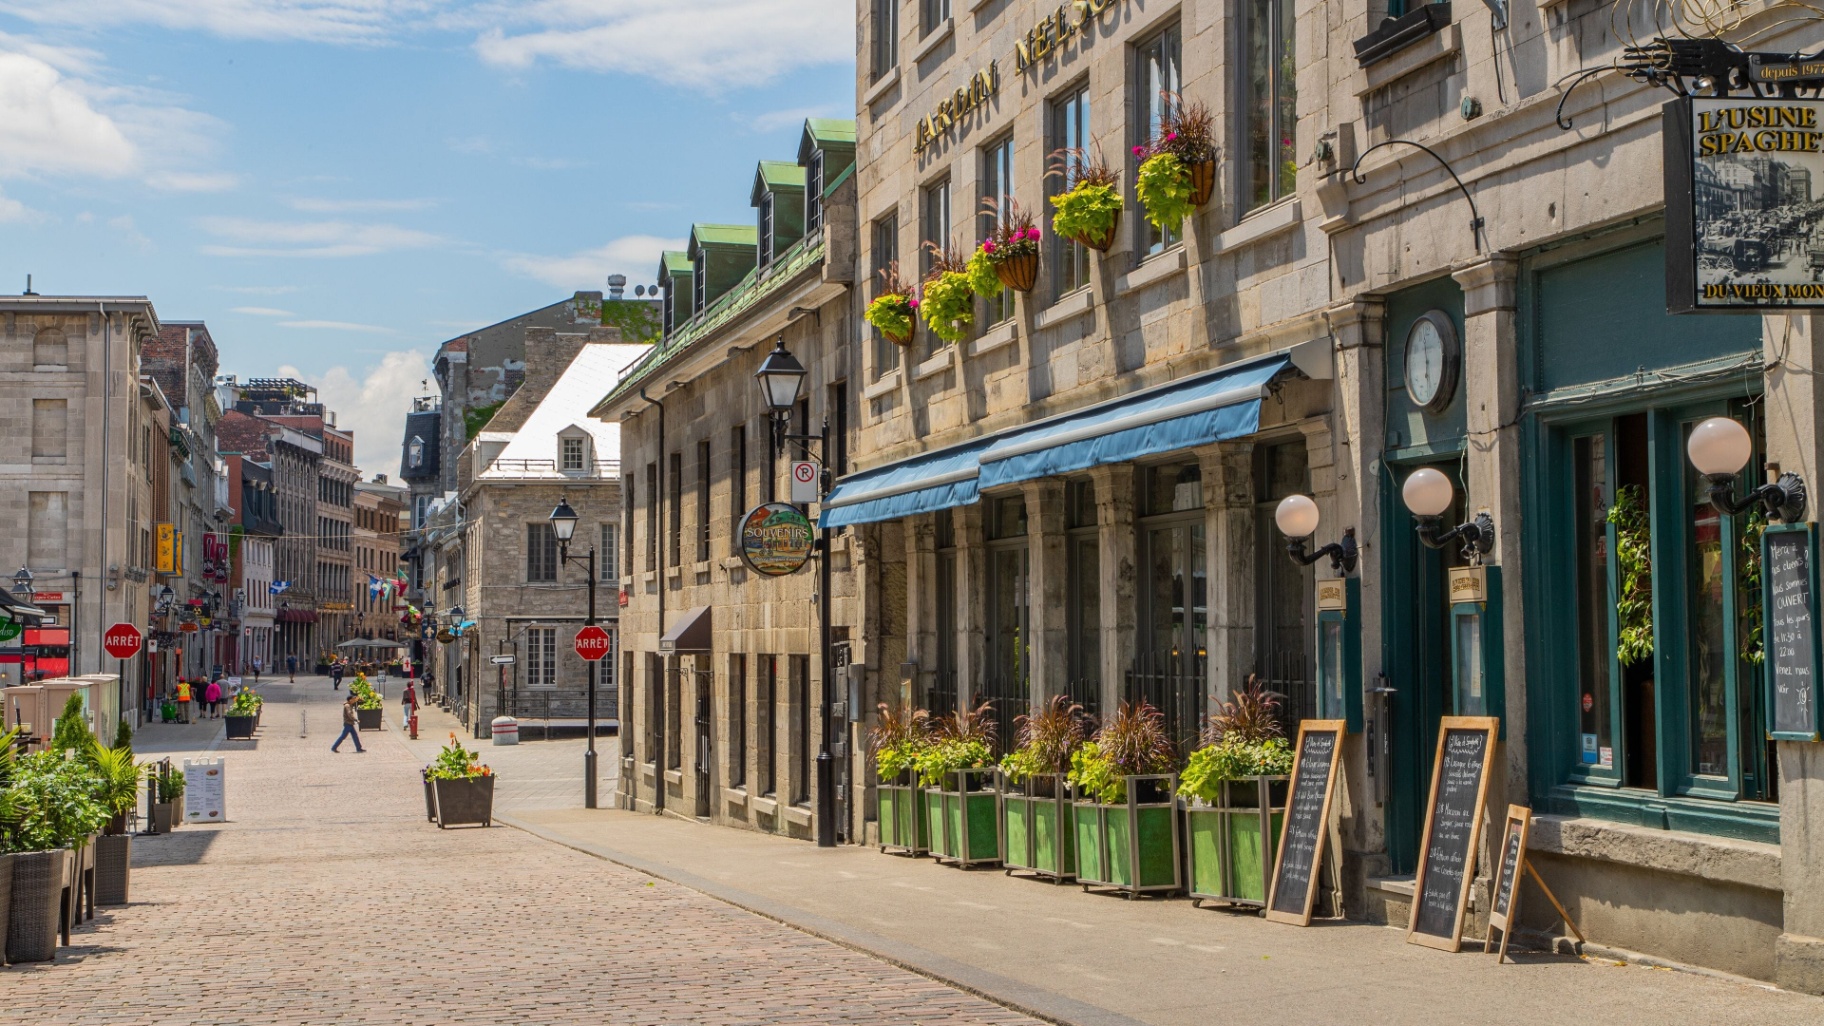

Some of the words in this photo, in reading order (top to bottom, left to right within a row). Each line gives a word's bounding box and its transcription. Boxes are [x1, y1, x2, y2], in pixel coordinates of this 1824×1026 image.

[913, 59, 998, 154] JARDIN
[1014, 0, 1124, 76] NELS
[1760, 65, 1799, 80] depuis
[1698, 106, 1817, 133] L'USINE
[1699, 130, 1824, 158] SPAGHE
[1703, 283, 1730, 298] DU
[1732, 283, 1783, 299] VIEUX
[747, 527, 809, 538] SOUVENIRS
[1770, 542, 1790, 560] Merci
[1777, 592, 1809, 610] OUVERT
[105, 634, 140, 647] ARRÊT
[576, 636, 608, 649] ARRÊT
